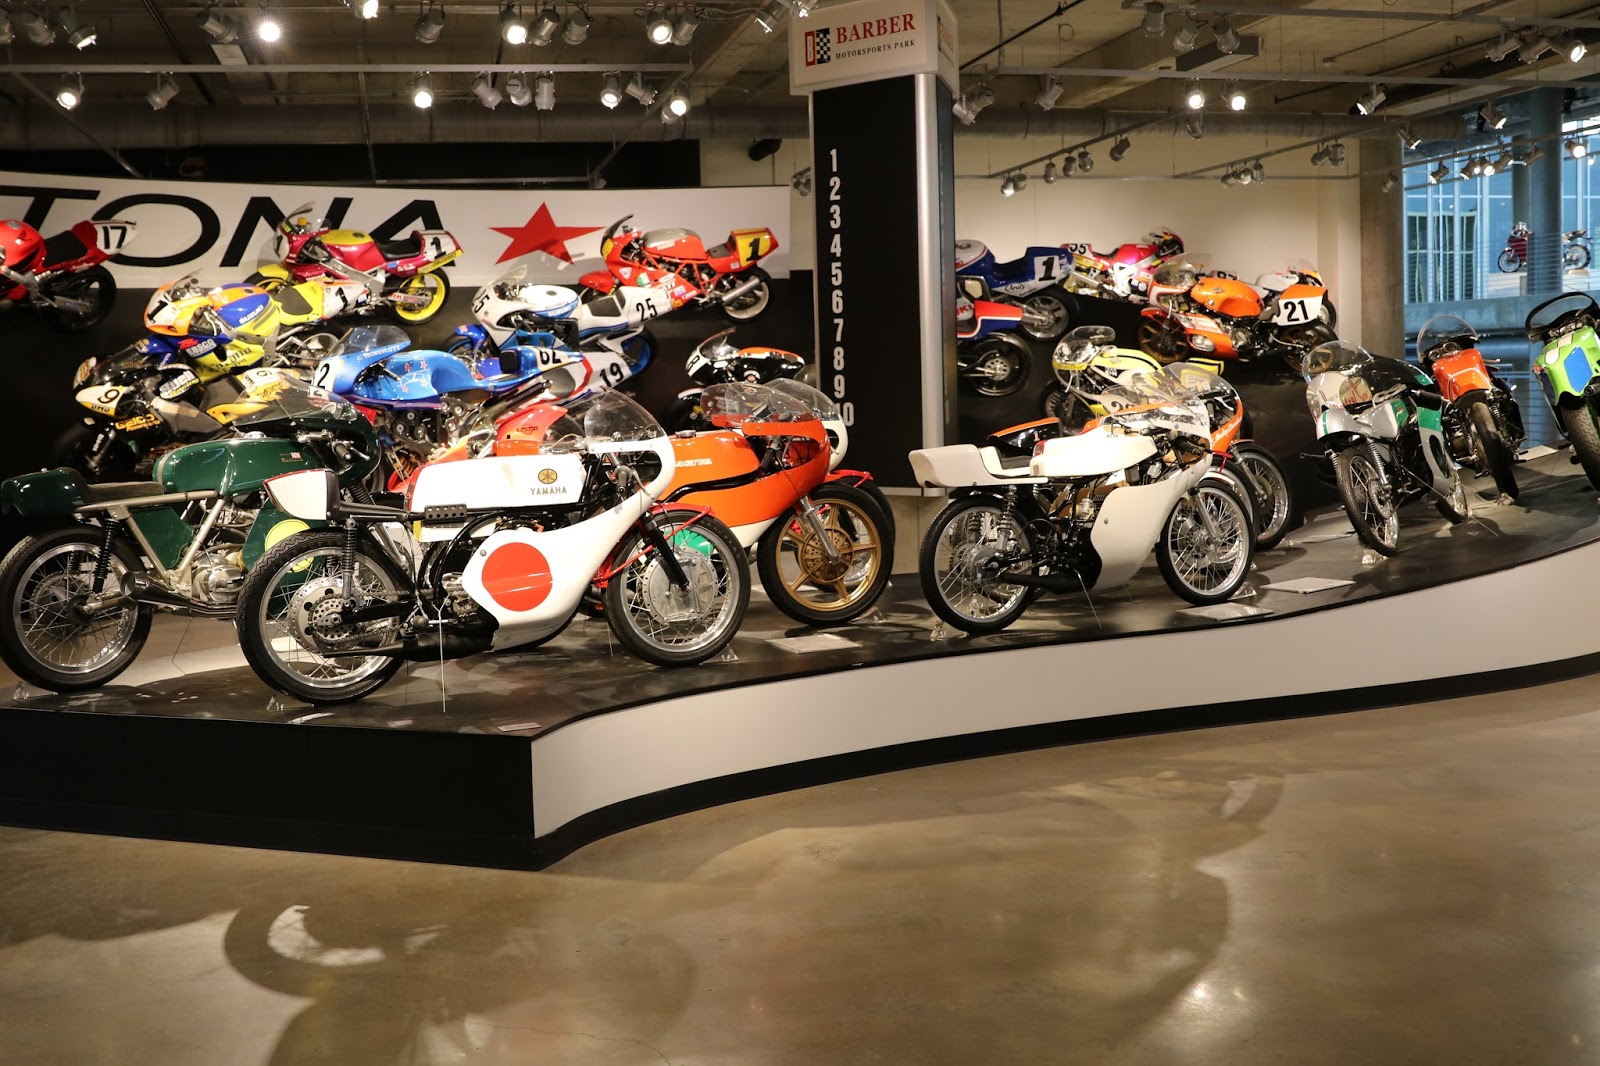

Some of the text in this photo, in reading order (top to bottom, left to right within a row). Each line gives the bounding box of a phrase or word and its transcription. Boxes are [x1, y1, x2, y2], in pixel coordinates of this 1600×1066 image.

[836, 13, 916, 44] BARBER
[836, 39, 915, 60] MOTORSPORTS PARK
[829, 148, 838, 172] 1
[829, 176, 841, 201] 2
[829, 204, 842, 229] 3
[102, 225, 127, 250] 17
[430, 236, 447, 259] 1
[746, 237, 762, 262] 1
[830, 234, 842, 257] 4
[831, 262, 843, 286] 5
[1038, 256, 1056, 281] 1
[334, 287, 349, 309] 1
[636, 297, 659, 323] 25
[831, 289, 844, 314] 6
[146, 300, 169, 324] 1
[1283, 299, 1309, 322] 21
[833, 318, 844, 342] 7
[833, 346, 845, 371] 8
[599, 361, 624, 388] 19
[834, 374, 846, 399] 9
[98, 388, 120, 403] 9
[530, 485, 568, 496] YAMAHA
